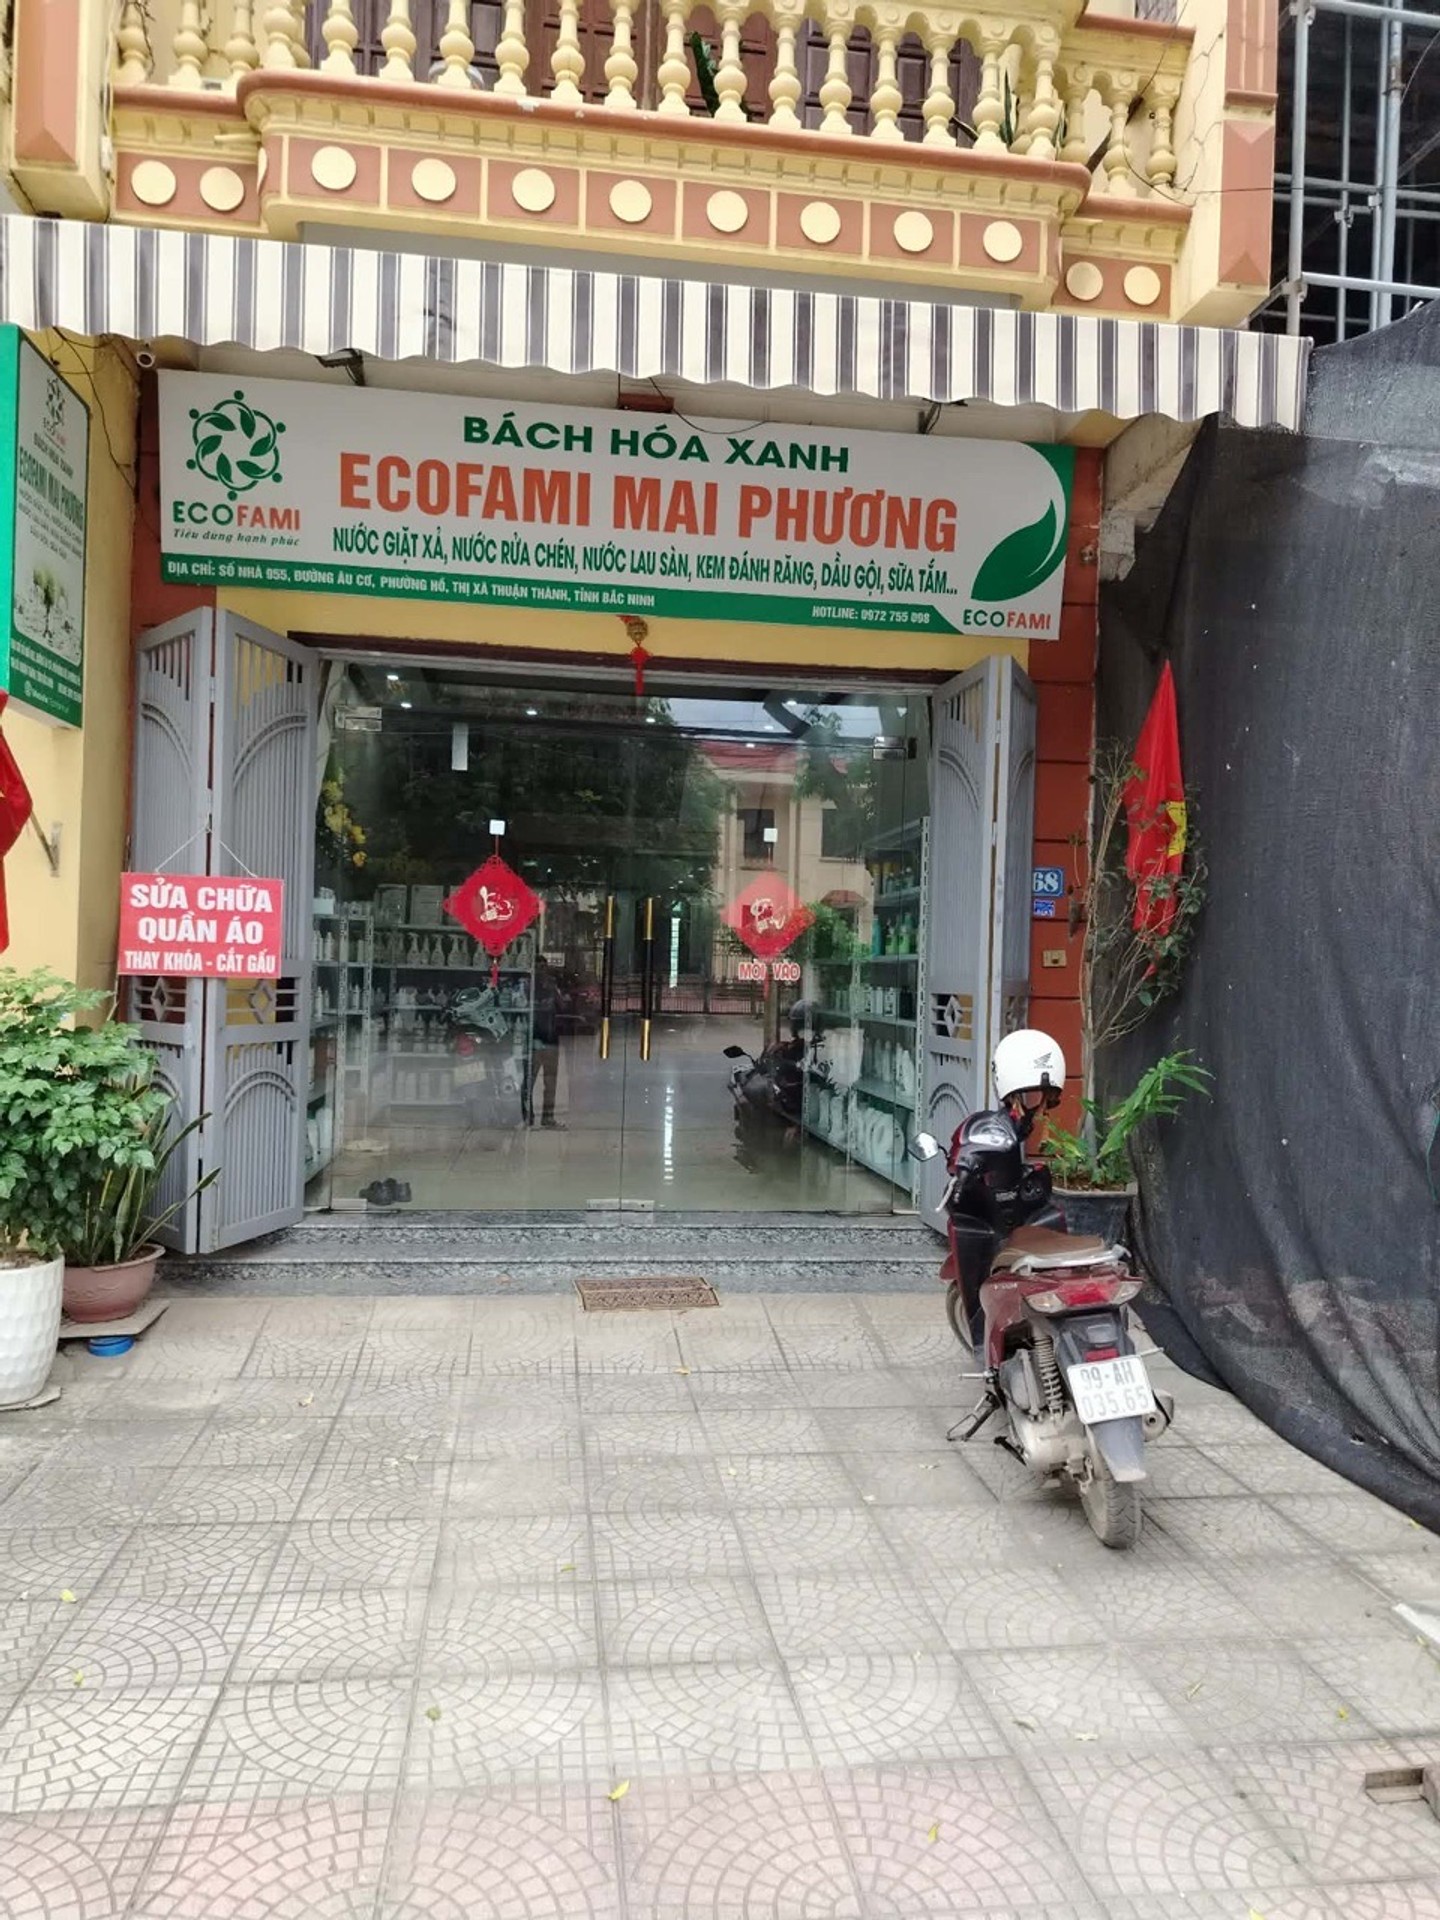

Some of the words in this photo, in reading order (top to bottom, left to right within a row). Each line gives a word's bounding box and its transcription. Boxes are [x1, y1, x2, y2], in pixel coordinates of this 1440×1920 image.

[463, 411, 593, 453] BÁCH
[610, 424, 710, 463] HÓA
[724, 437, 850, 473] XANH
[172, 500, 300, 530] ECOFAMI
[340, 452, 591, 527] ECOFAMI
[613, 475, 718, 536] MAI
[739, 484, 958, 552] PHƯƠNG
[333, 522, 379, 554] NƯỚC
[383, 526, 418, 564] GIẶT
[422, 526, 448, 565] XẢ,
[452, 531, 498, 563] NƯỚC
[501, 531, 530, 566] RỬA
[534, 537, 579, 574] CHÉN,
[583, 541, 627, 573] NƯỚC
[630, 549, 656, 575] LAU
[659, 545, 691, 582] SÀN,
[696, 554, 725, 579] KEM
[729, 550, 770, 583] ĐÁNH
[774, 554, 817, 590] RĂNG,
[821, 551, 851, 588] DẦU
[854, 559, 885, 596] GỘI,
[888, 562, 914, 592] SỮA
[919, 558, 958, 595] TẮM...
[167, 560, 189, 577] ĐỊA
[191, 559, 216, 576] CHỈ:
[218, 560, 236, 577] SỐ
[238, 564, 263, 579] NHÀ
[294, 567, 334, 585] ĐƯỜNG
[337, 570, 353, 585] ÂU
[380, 574, 428, 591] PHƯỜNG
[452, 580, 470, 597] THỊ
[491, 582, 528, 600] THUẬN
[602, 588, 624, 605] BẮC
[627, 593, 655, 607] NINH
[812, 605, 858, 620] HOTLINE:
[860, 608, 886, 622] 0972
[889, 610, 908, 623] 755
[963, 609, 1051, 630] ECOFAMI
[130, 877, 189, 910] SỬA
[197, 884, 273, 913] CHỮA
[138, 911, 218, 943] QUẦN
[225, 916, 264, 945] ÁO
[124, 950, 160, 969] THAY
[163, 949, 203, 971] KHÓA
[216, 947, 244, 972] CẮT
[247, 948, 276, 973] GẤU
